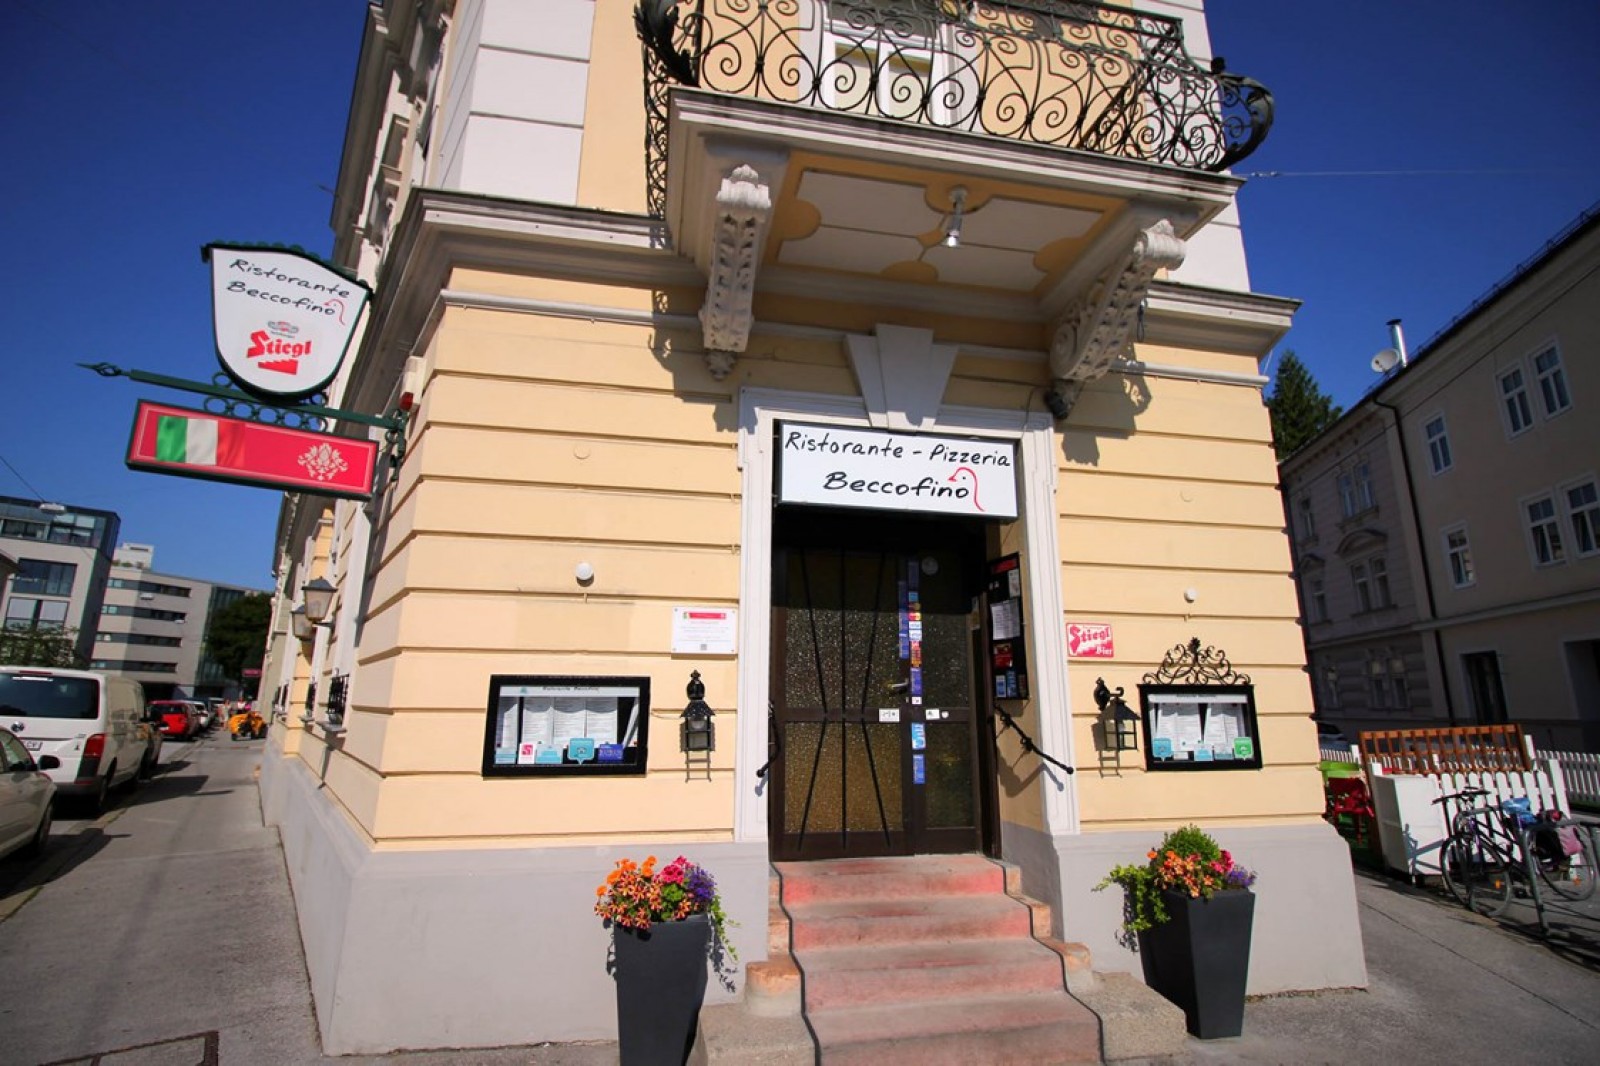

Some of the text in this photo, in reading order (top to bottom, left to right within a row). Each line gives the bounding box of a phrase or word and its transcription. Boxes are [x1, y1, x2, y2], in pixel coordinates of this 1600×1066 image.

[230, 259, 350, 298] Ristorante
[227, 281, 336, 316] Beccofino
[247, 329, 312, 358] Stiegl
[785, 431, 904, 458] Ristorante
[929, 443, 1011, 467] Pizzeria
[823, 471, 970, 499] Beccofino
[1069, 625, 1110, 654] Stiegl
